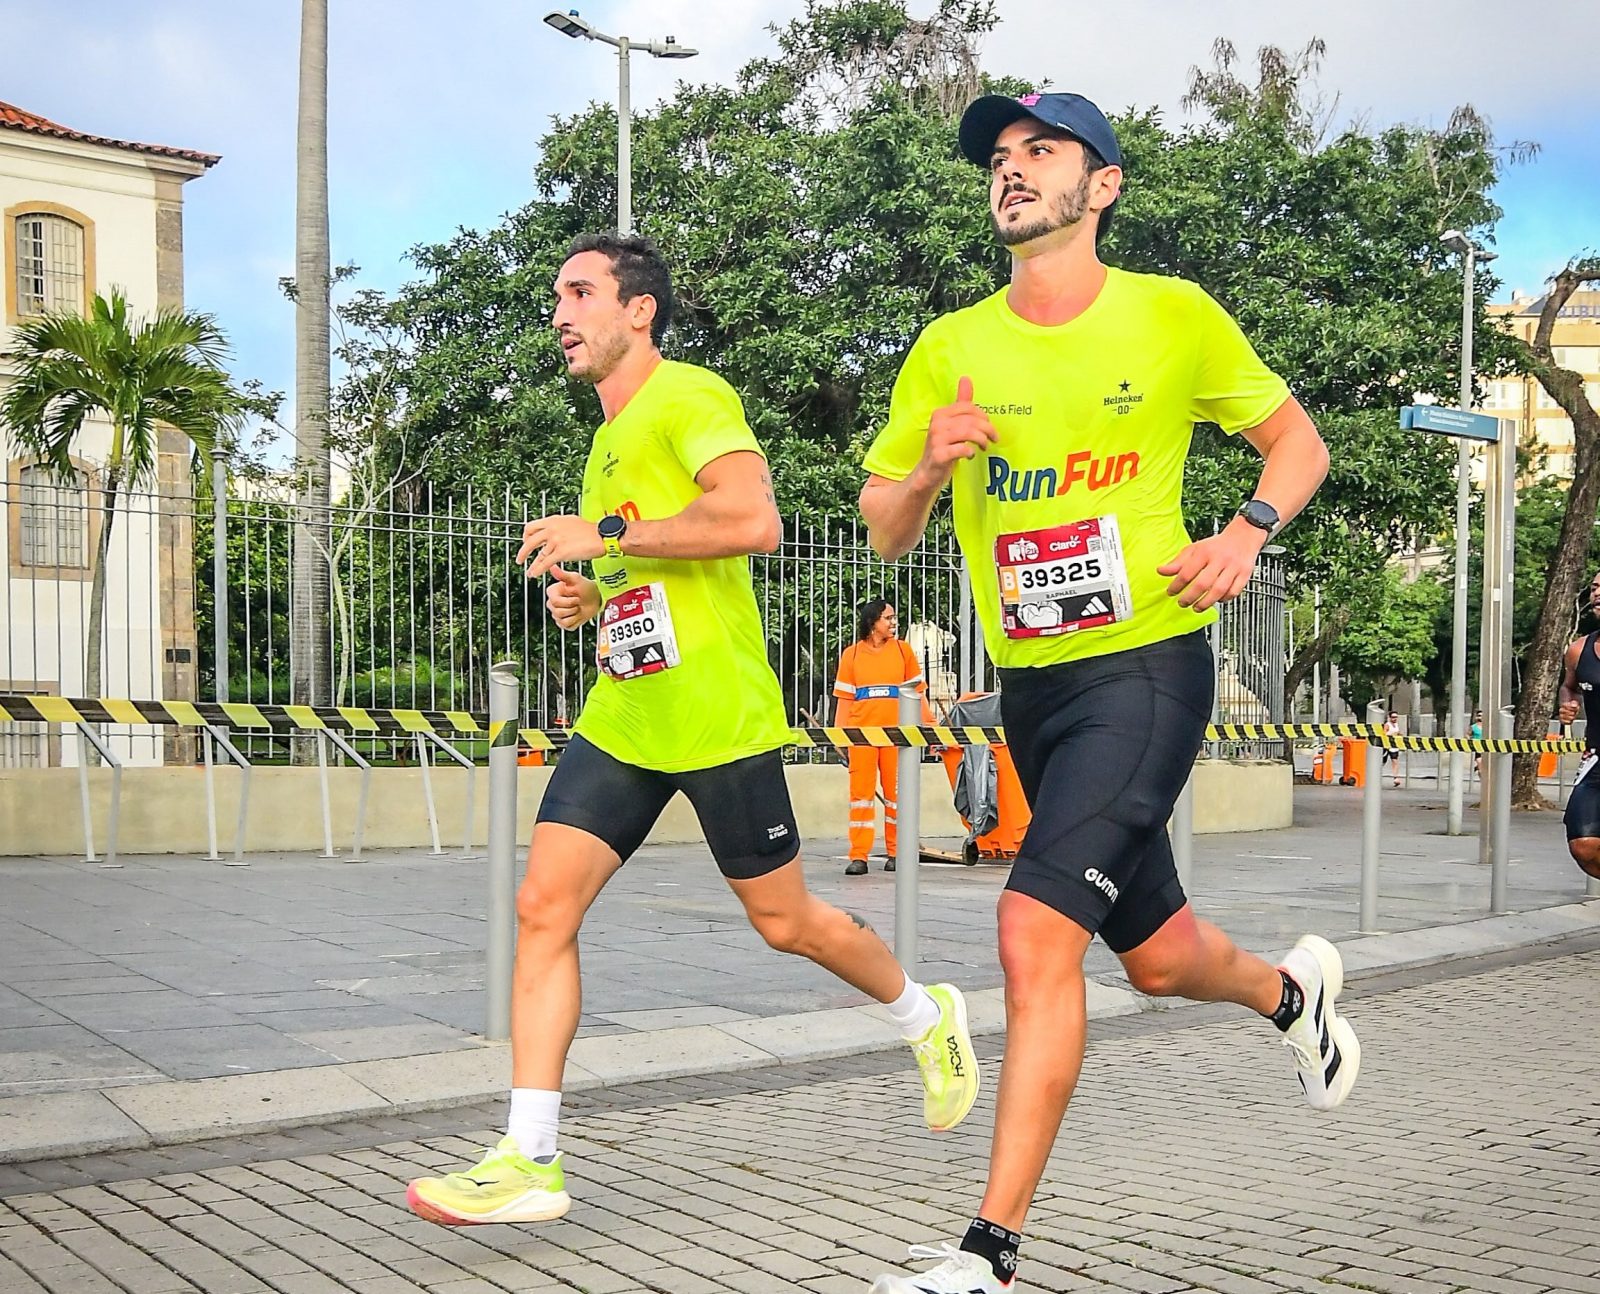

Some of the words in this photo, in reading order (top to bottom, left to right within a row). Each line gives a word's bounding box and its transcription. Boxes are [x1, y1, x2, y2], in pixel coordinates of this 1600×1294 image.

[1103, 394, 1143, 406] Heineken
[1008, 404, 1032, 415] Field
[1049, 537, 1080, 552] Claro
[1003, 571, 1016, 591] B
[1021, 558, 1102, 589] 39325
[1046, 589, 1078, 600] RAPHAEL
[610, 617, 655, 643] 39360
[946, 1035, 965, 1077] HOKA
